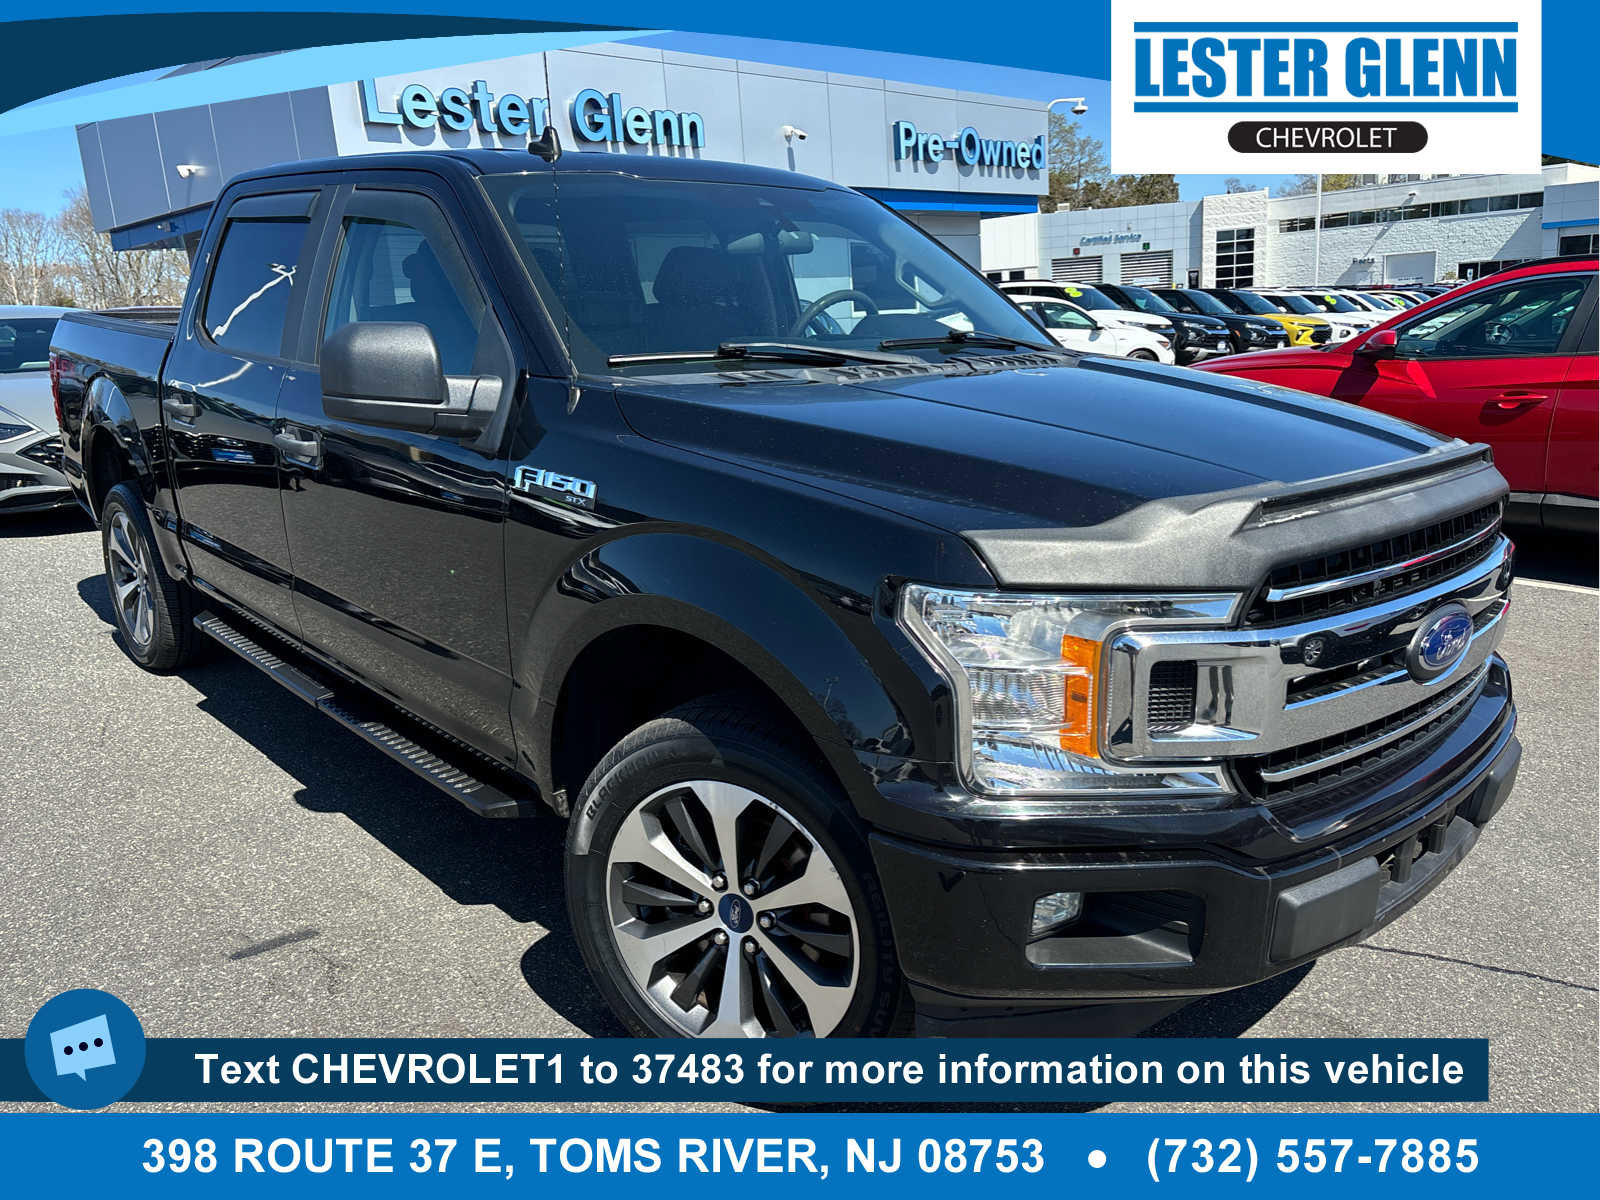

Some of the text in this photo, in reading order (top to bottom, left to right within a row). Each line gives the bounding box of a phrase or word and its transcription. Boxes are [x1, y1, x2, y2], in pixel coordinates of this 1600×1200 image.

[359, 79, 705, 148] Lester Glenn
[893, 120, 1046, 169] Pre-Owned
[566, 495, 586, 506] STX
